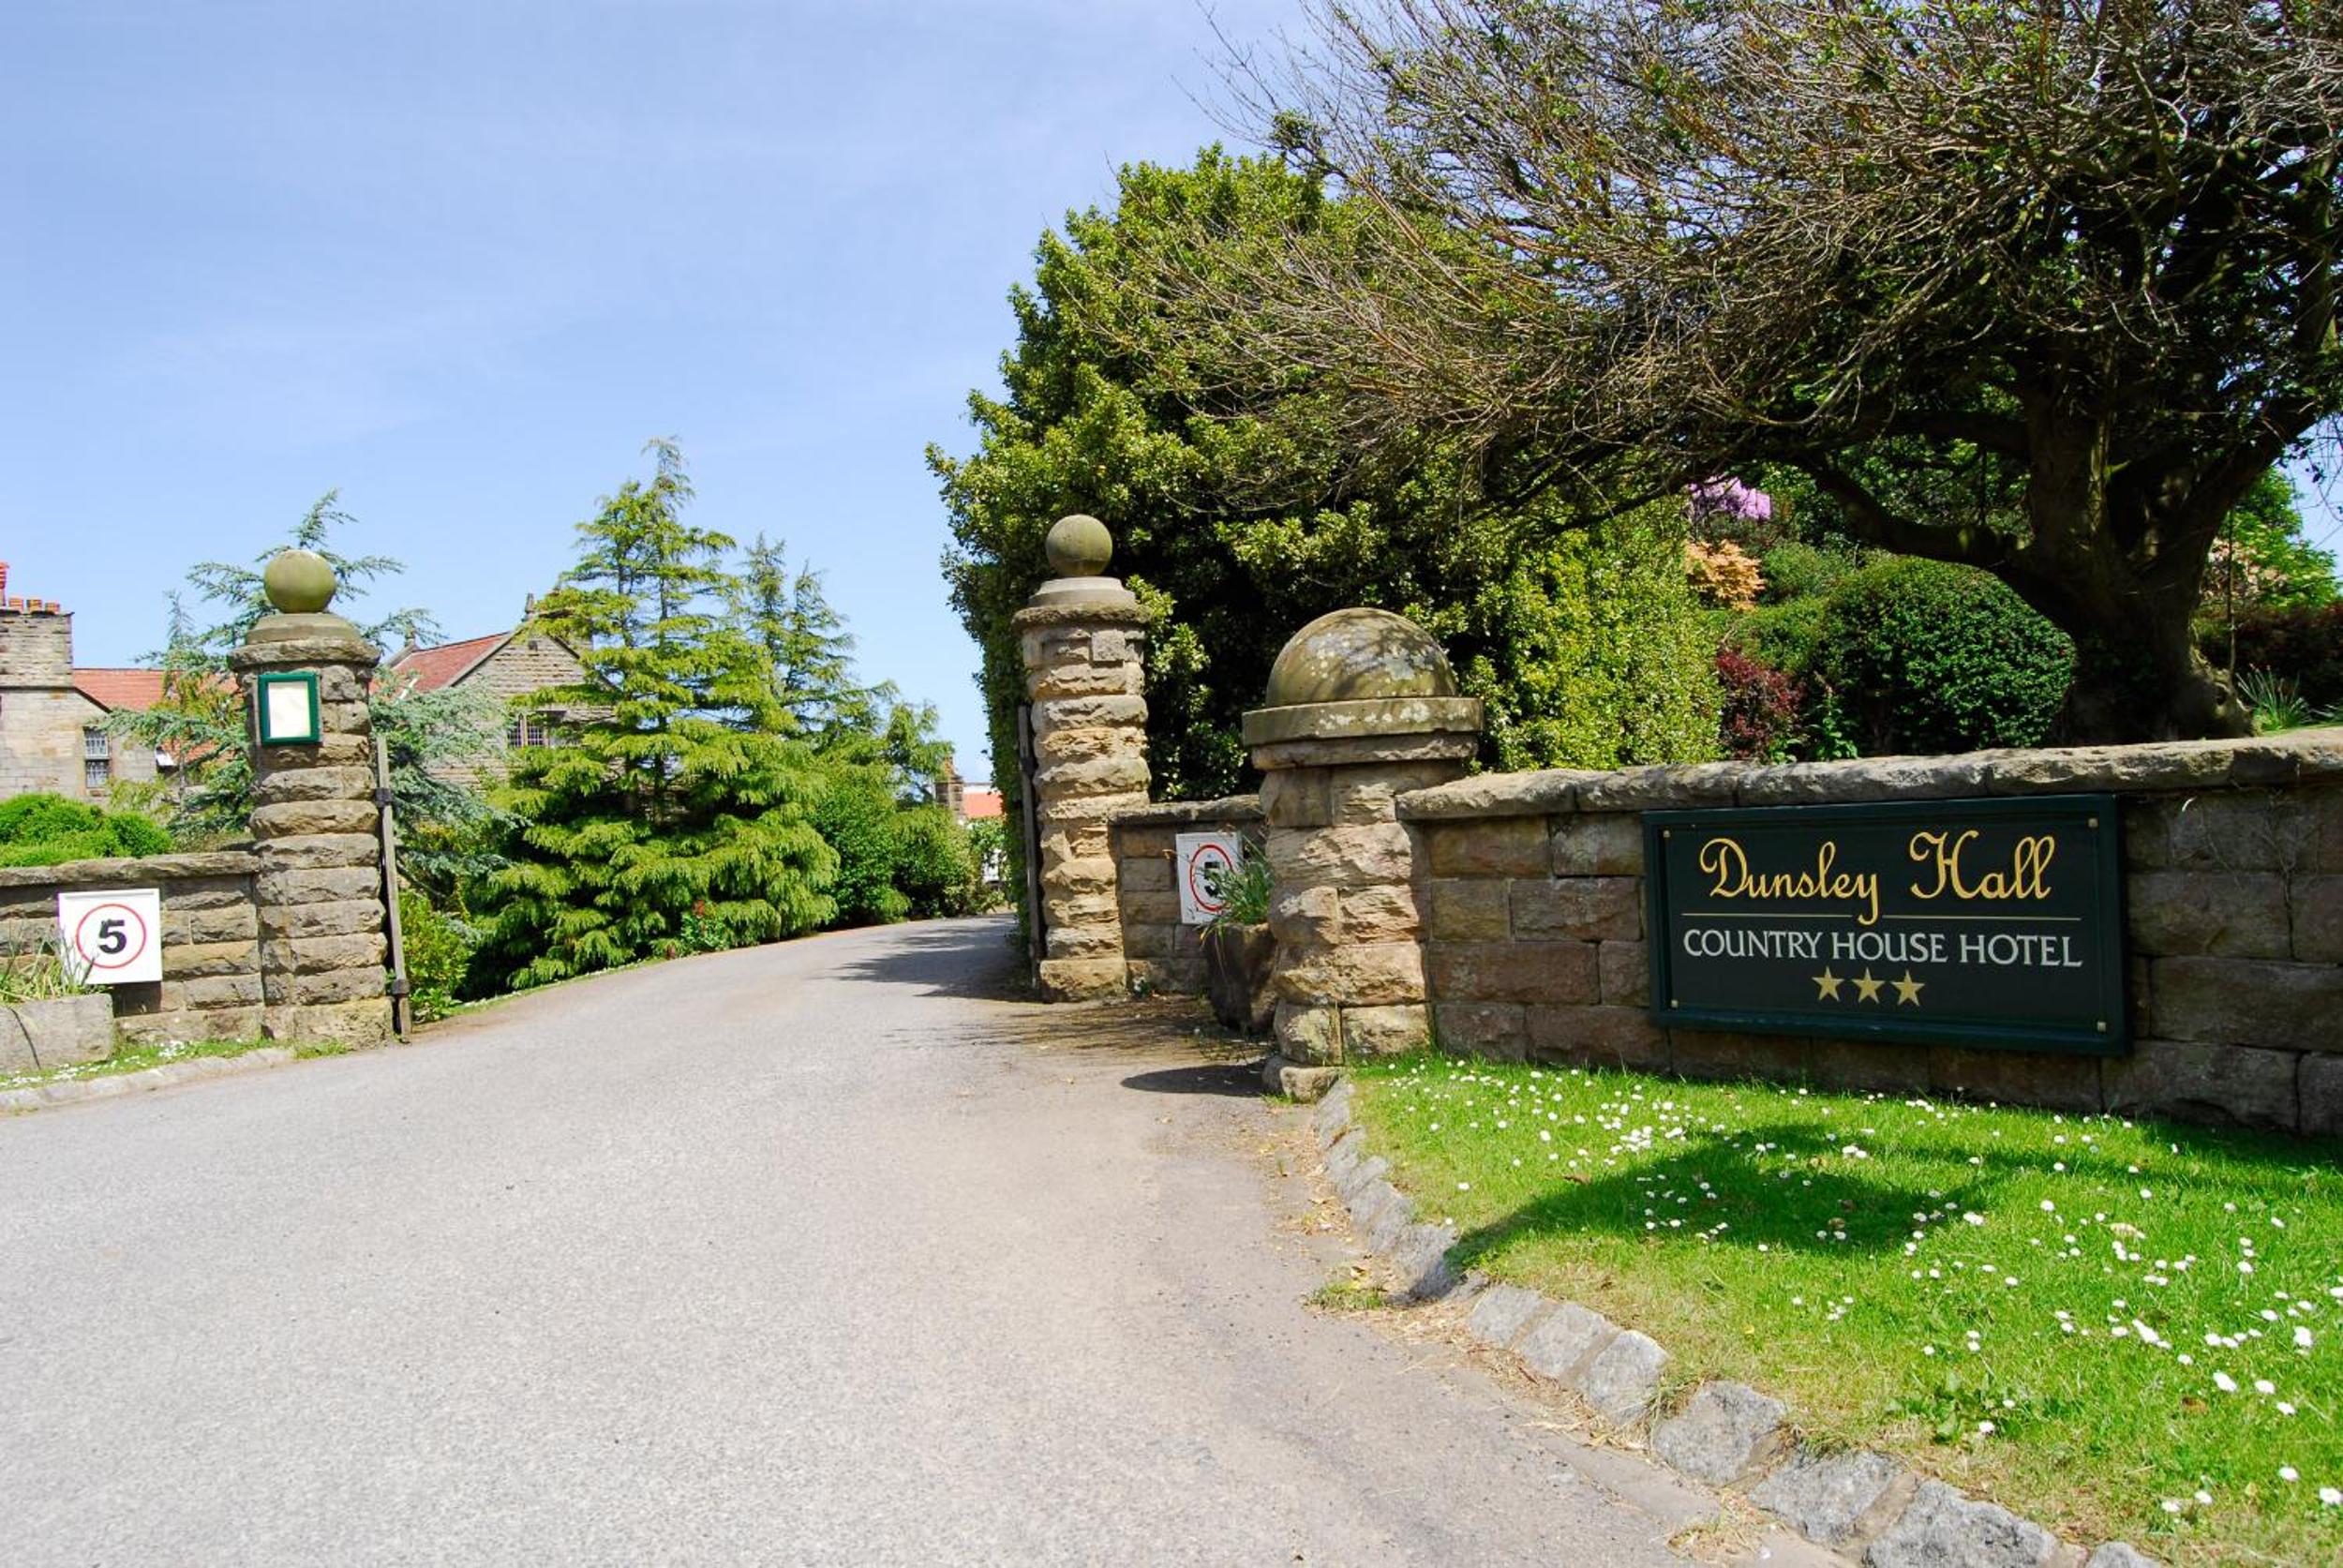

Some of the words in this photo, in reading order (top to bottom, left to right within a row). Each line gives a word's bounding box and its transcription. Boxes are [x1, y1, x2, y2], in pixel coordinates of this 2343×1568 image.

[1699, 837, 1880, 926] Dunsley
[1909, 829, 2056, 901] Hall
[98, 918, 127, 955] 5
[1683, 929, 1825, 960] COUNTRY
[1832, 932, 1948, 963] HOUSE
[1960, 933, 2082, 968] HOTEL
